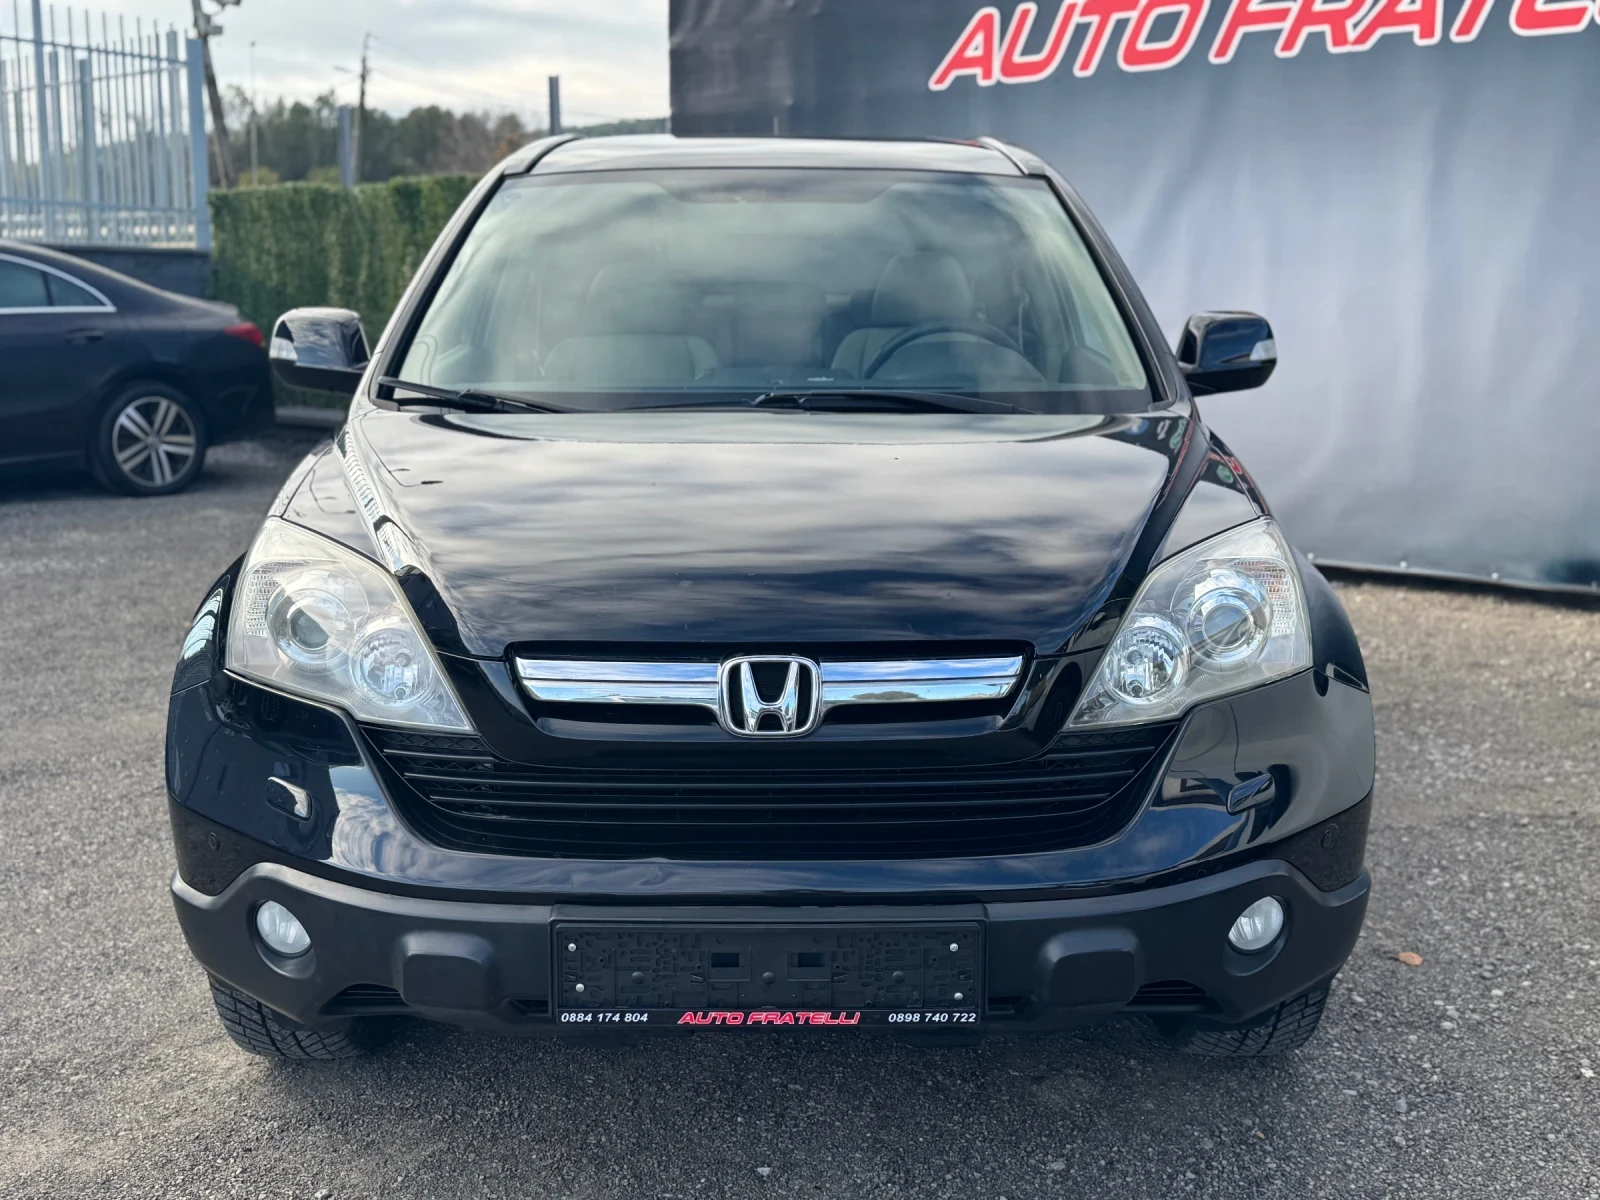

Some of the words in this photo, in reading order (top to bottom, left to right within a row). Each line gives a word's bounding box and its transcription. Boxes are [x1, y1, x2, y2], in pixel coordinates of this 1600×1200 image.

[927, 0, 1212, 91] AUTO
[1207, 0, 1600, 65] FRA
[561, 1012, 592, 1023] 0884
[597, 1012, 621, 1023] 174
[624, 1012, 649, 1023] 804
[677, 1011, 744, 1025] AUTO
[747, 1011, 861, 1025] FRATELLI
[888, 1012, 920, 1023] 0898
[925, 1012, 948, 1023] 740
[952, 1012, 977, 1023] 722
